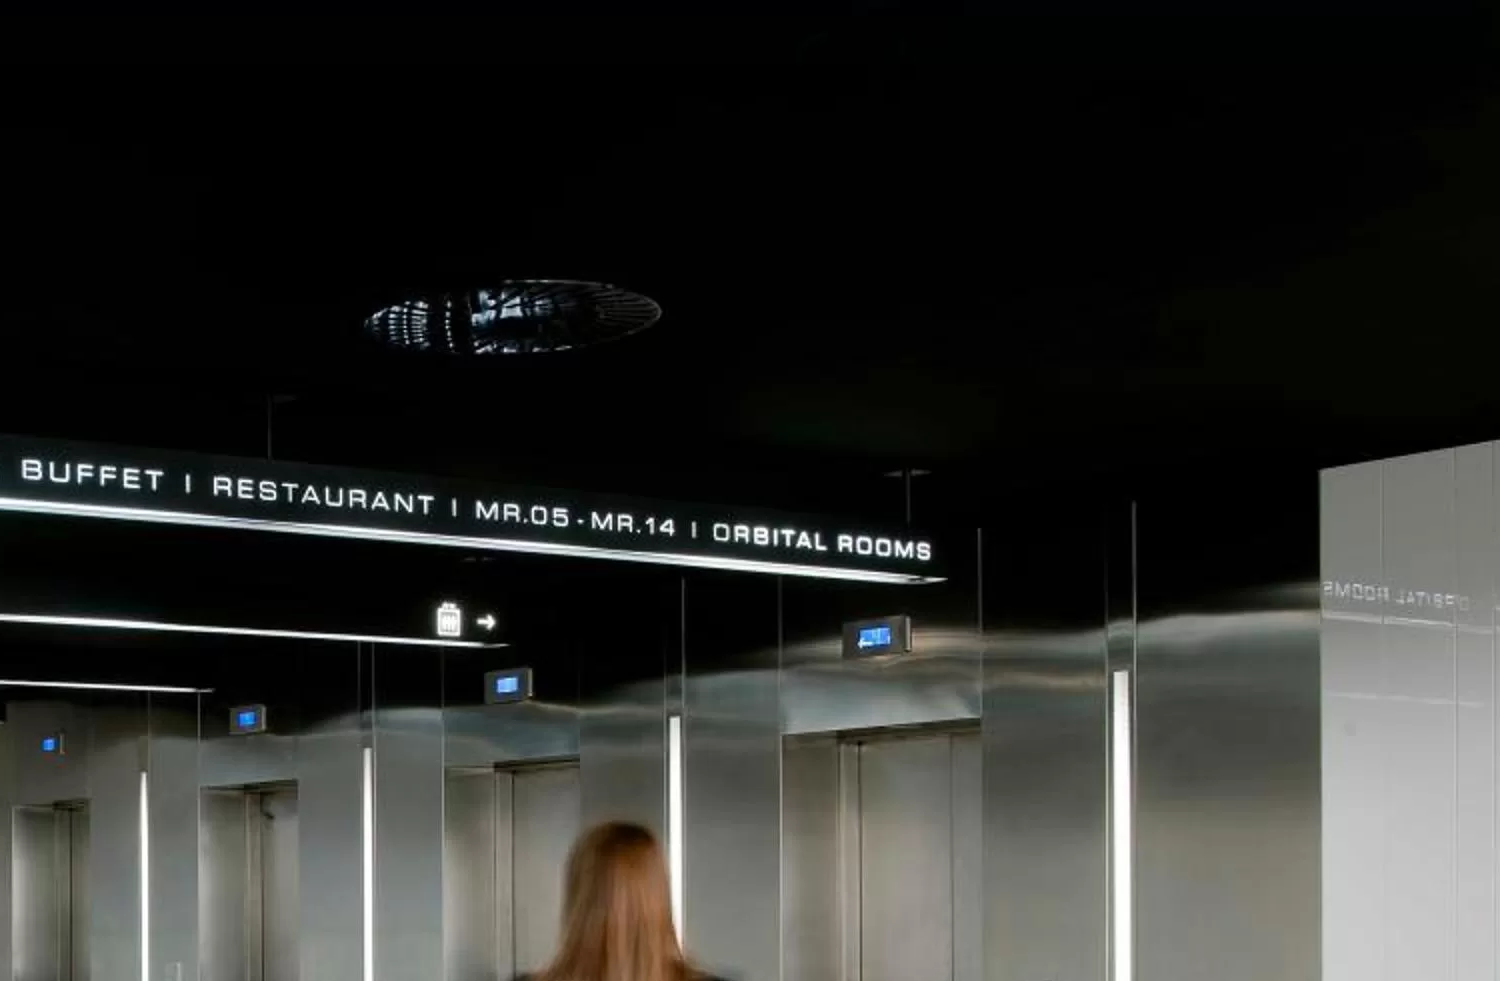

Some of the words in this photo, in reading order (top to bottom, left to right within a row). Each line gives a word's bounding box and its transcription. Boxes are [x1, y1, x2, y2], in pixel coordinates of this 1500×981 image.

[21, 458, 165, 491] BUFFET
[213, 475, 435, 516] RESTAURANT
[712, 522, 828, 552] ORBITAL
[837, 533, 932, 561] ROOMS
